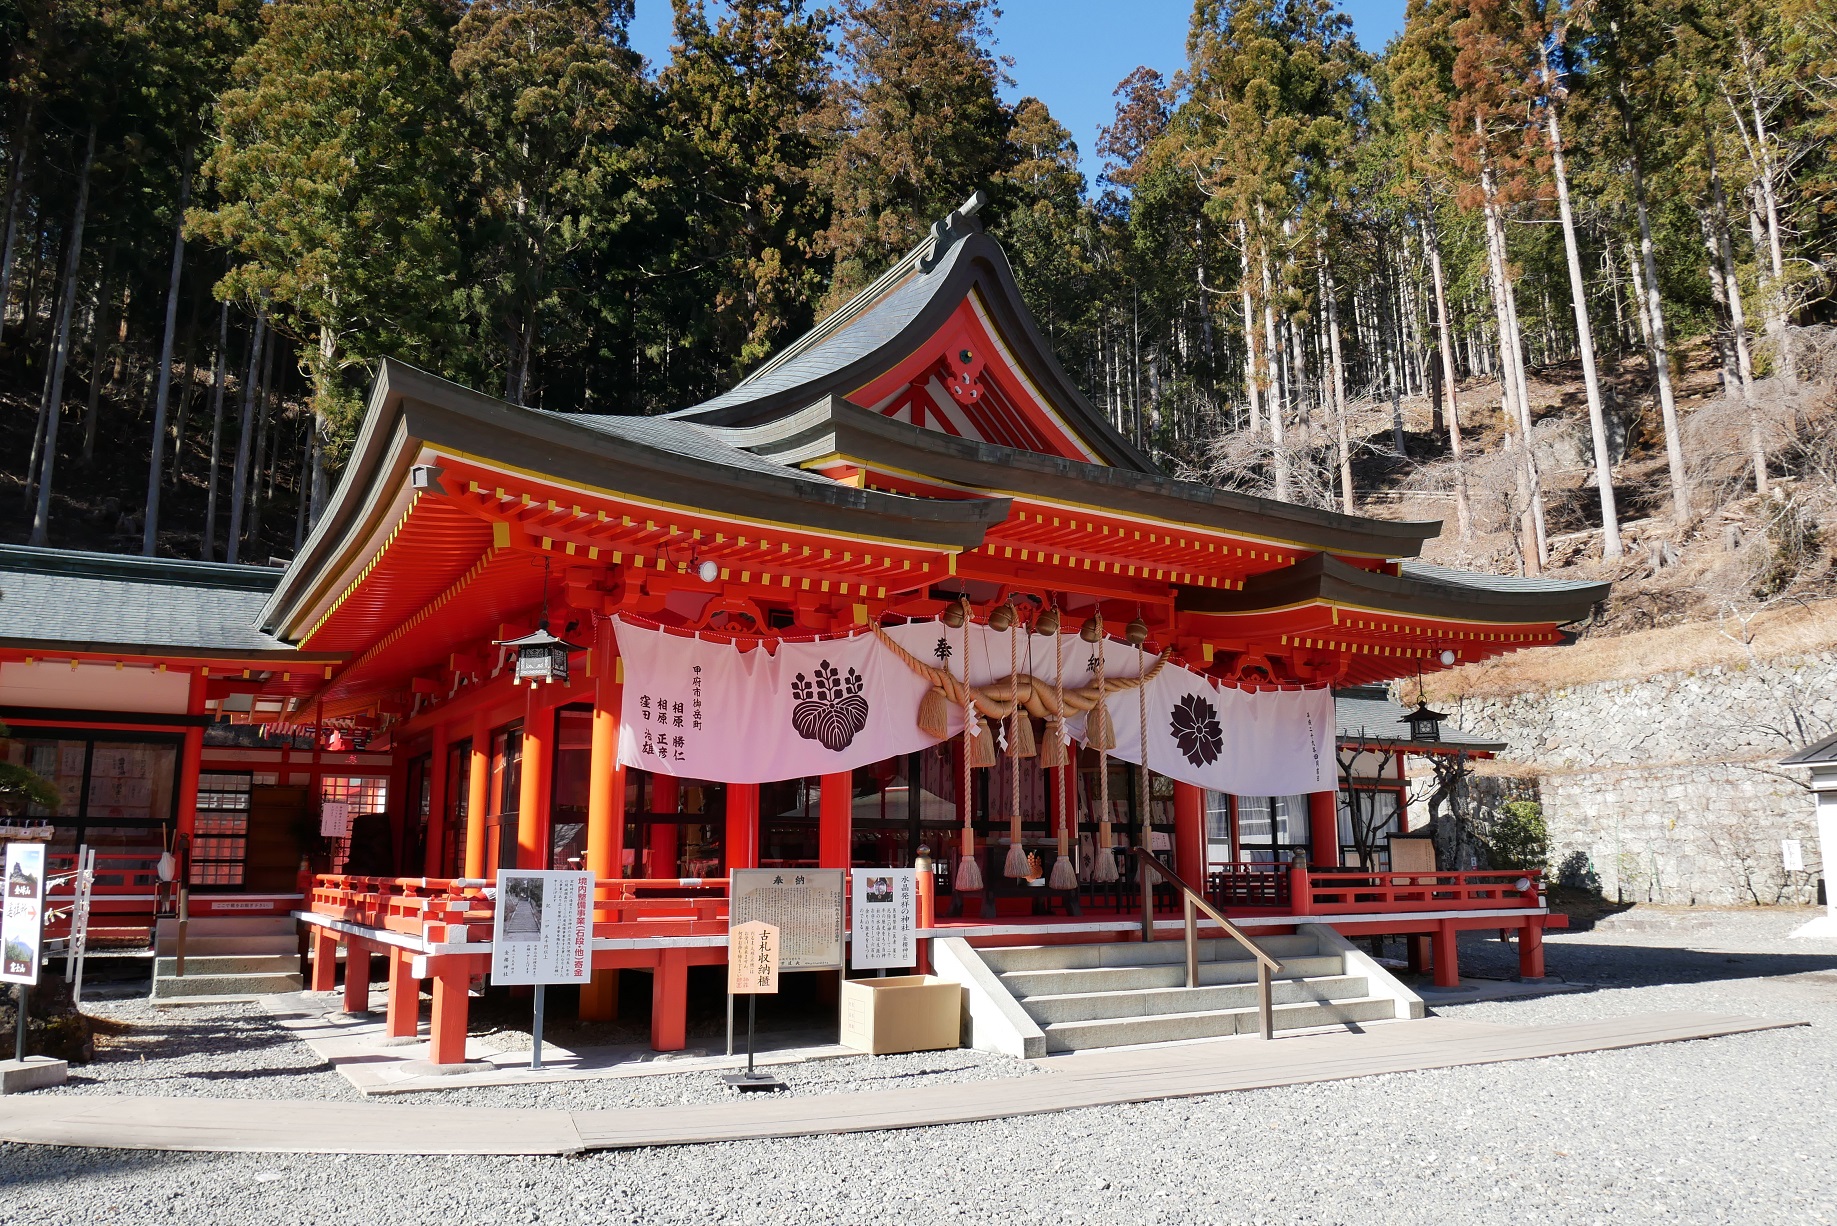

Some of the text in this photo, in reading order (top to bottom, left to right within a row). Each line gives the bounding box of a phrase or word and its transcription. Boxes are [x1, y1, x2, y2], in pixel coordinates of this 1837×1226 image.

[934, 637, 1105, 673] 奉 納
[692, 665, 702, 731] 甲府市御岳町
[656, 697, 668, 759] 相原 正彦
[672, 701, 685, 761] 相原 勝仁
[14, 884, 31, 896] 金峰山
[901, 875, 910, 931] 水晶発祥の神社
[10, 961, 26, 973] 富士山
[757, 929, 771, 987] 古札収納櫃
